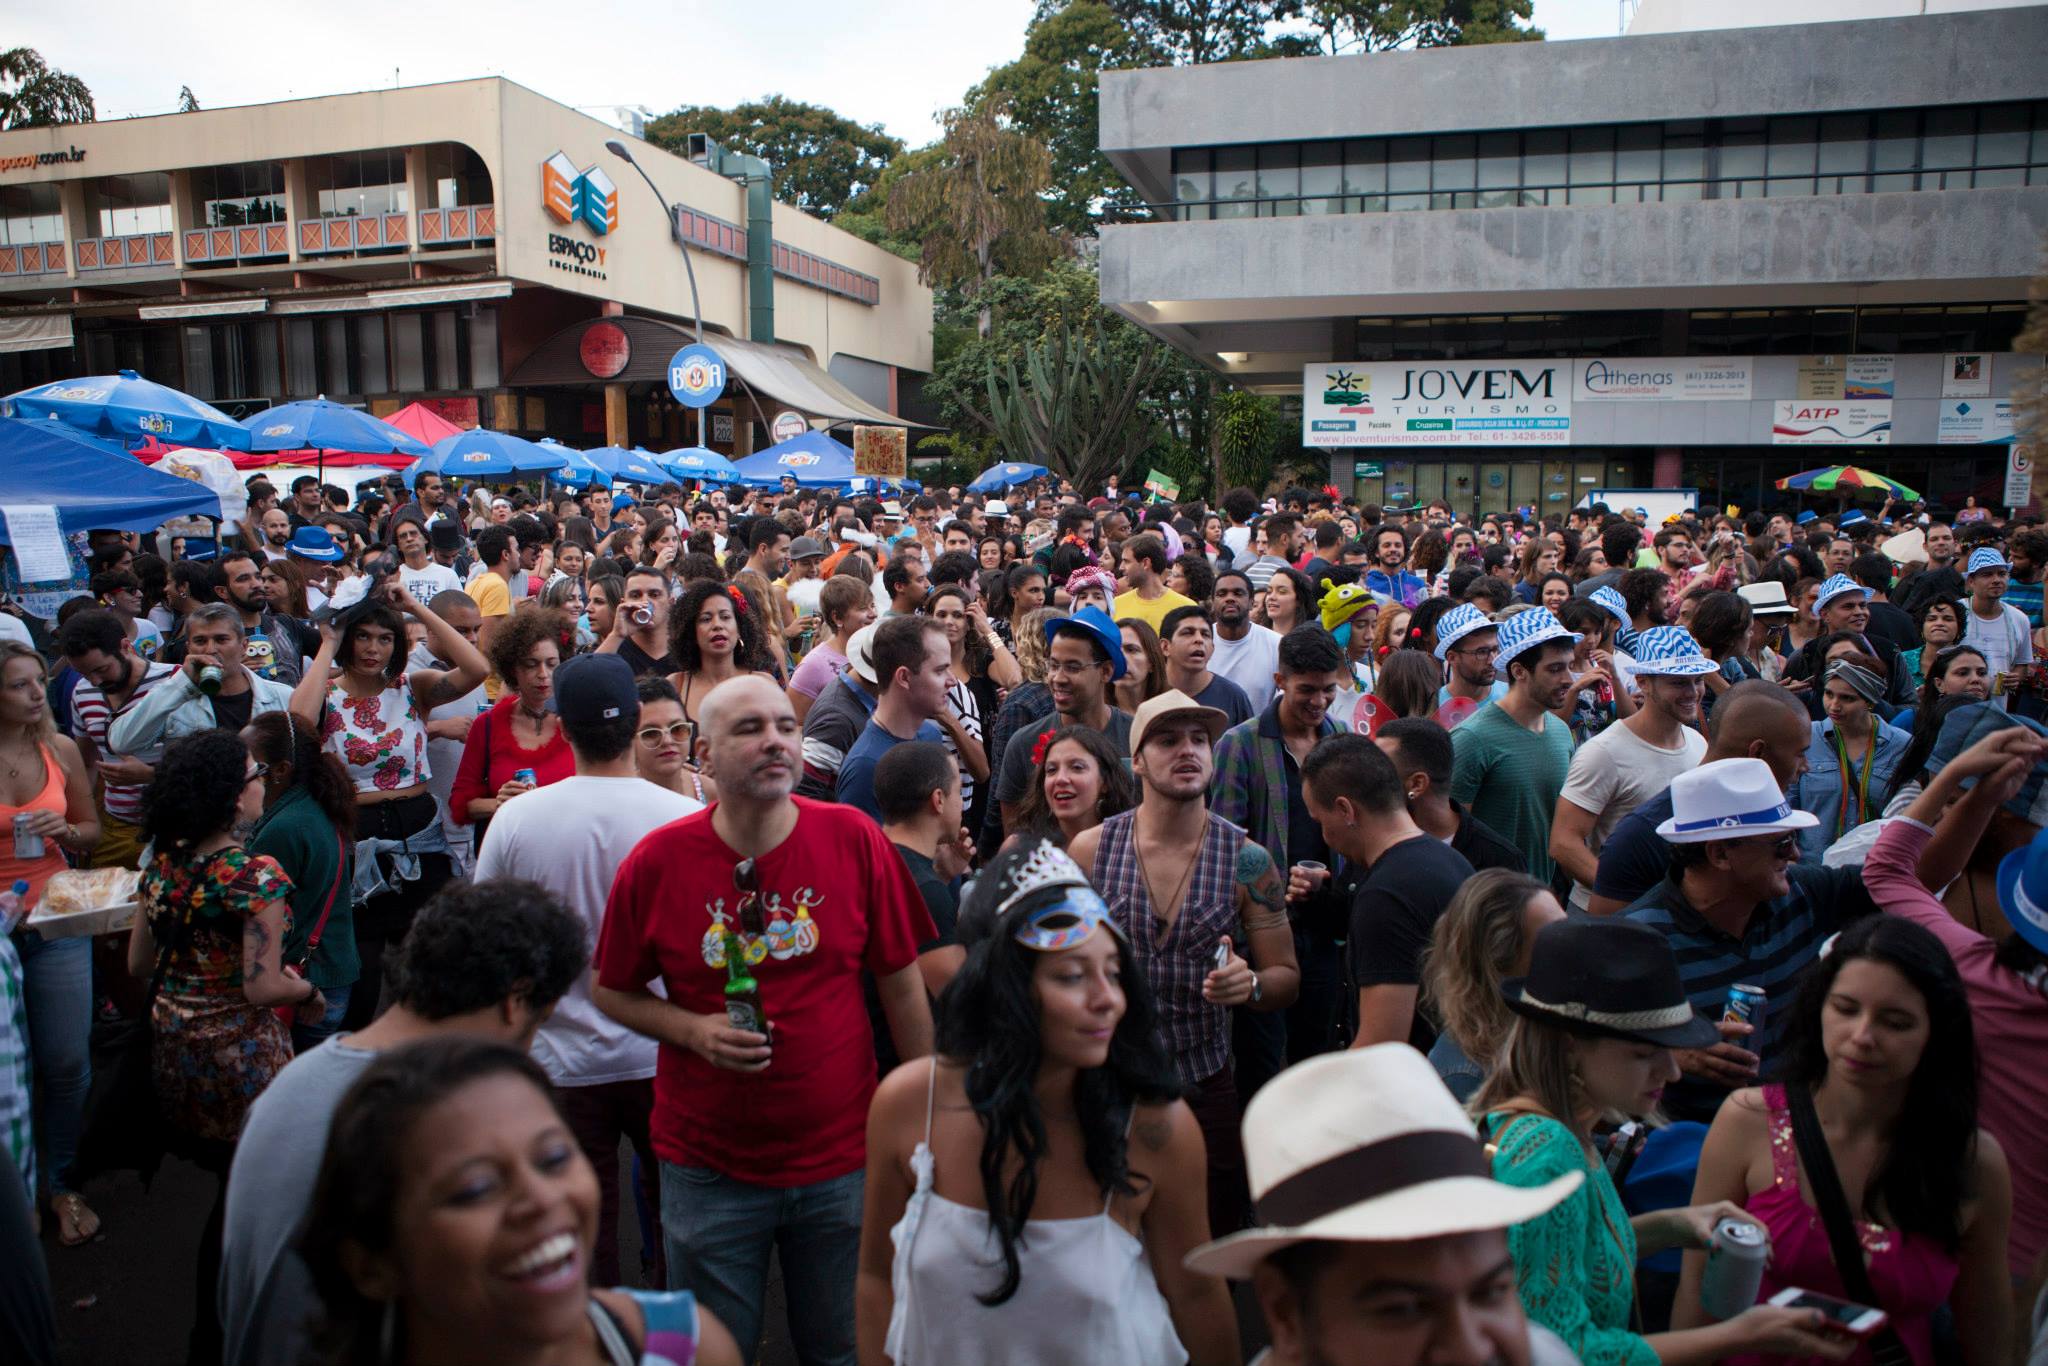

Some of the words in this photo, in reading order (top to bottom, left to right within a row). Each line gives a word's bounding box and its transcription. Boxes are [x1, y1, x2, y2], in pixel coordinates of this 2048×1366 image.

[548, 232, 597, 265] ESPAÇO
[598, 247, 606, 266] Y
[549, 258, 608, 281] ENGENHARIA
[1586, 360, 1673, 386] Athenas
[1392, 368, 1556, 401] JOVEM
[1393, 404, 1558, 416] TURISMO
[1796, 407, 1840, 420] ATP
[1415, 421, 1444, 429] Cruzeiros
[716, 428, 732, 441] 202
[1312, 432, 1462, 445] www.jovemturismo.com.br
[1511, 431, 1566, 441] 3426-5536
